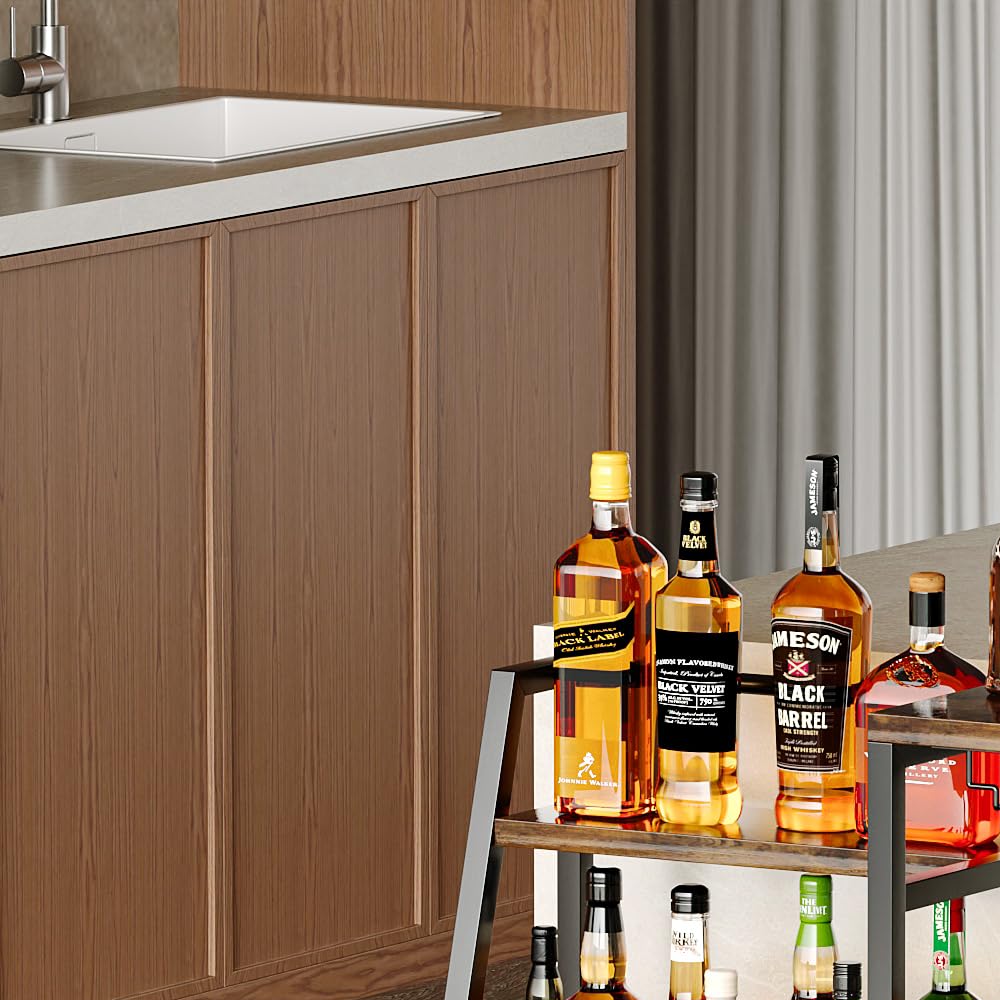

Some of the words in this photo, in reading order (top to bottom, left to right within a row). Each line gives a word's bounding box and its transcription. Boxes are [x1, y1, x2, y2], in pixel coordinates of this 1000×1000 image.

[808, 468, 818, 516] JAMESON
[691, 684, 726, 694] VELVET
[777, 708, 829, 730] BARREL
